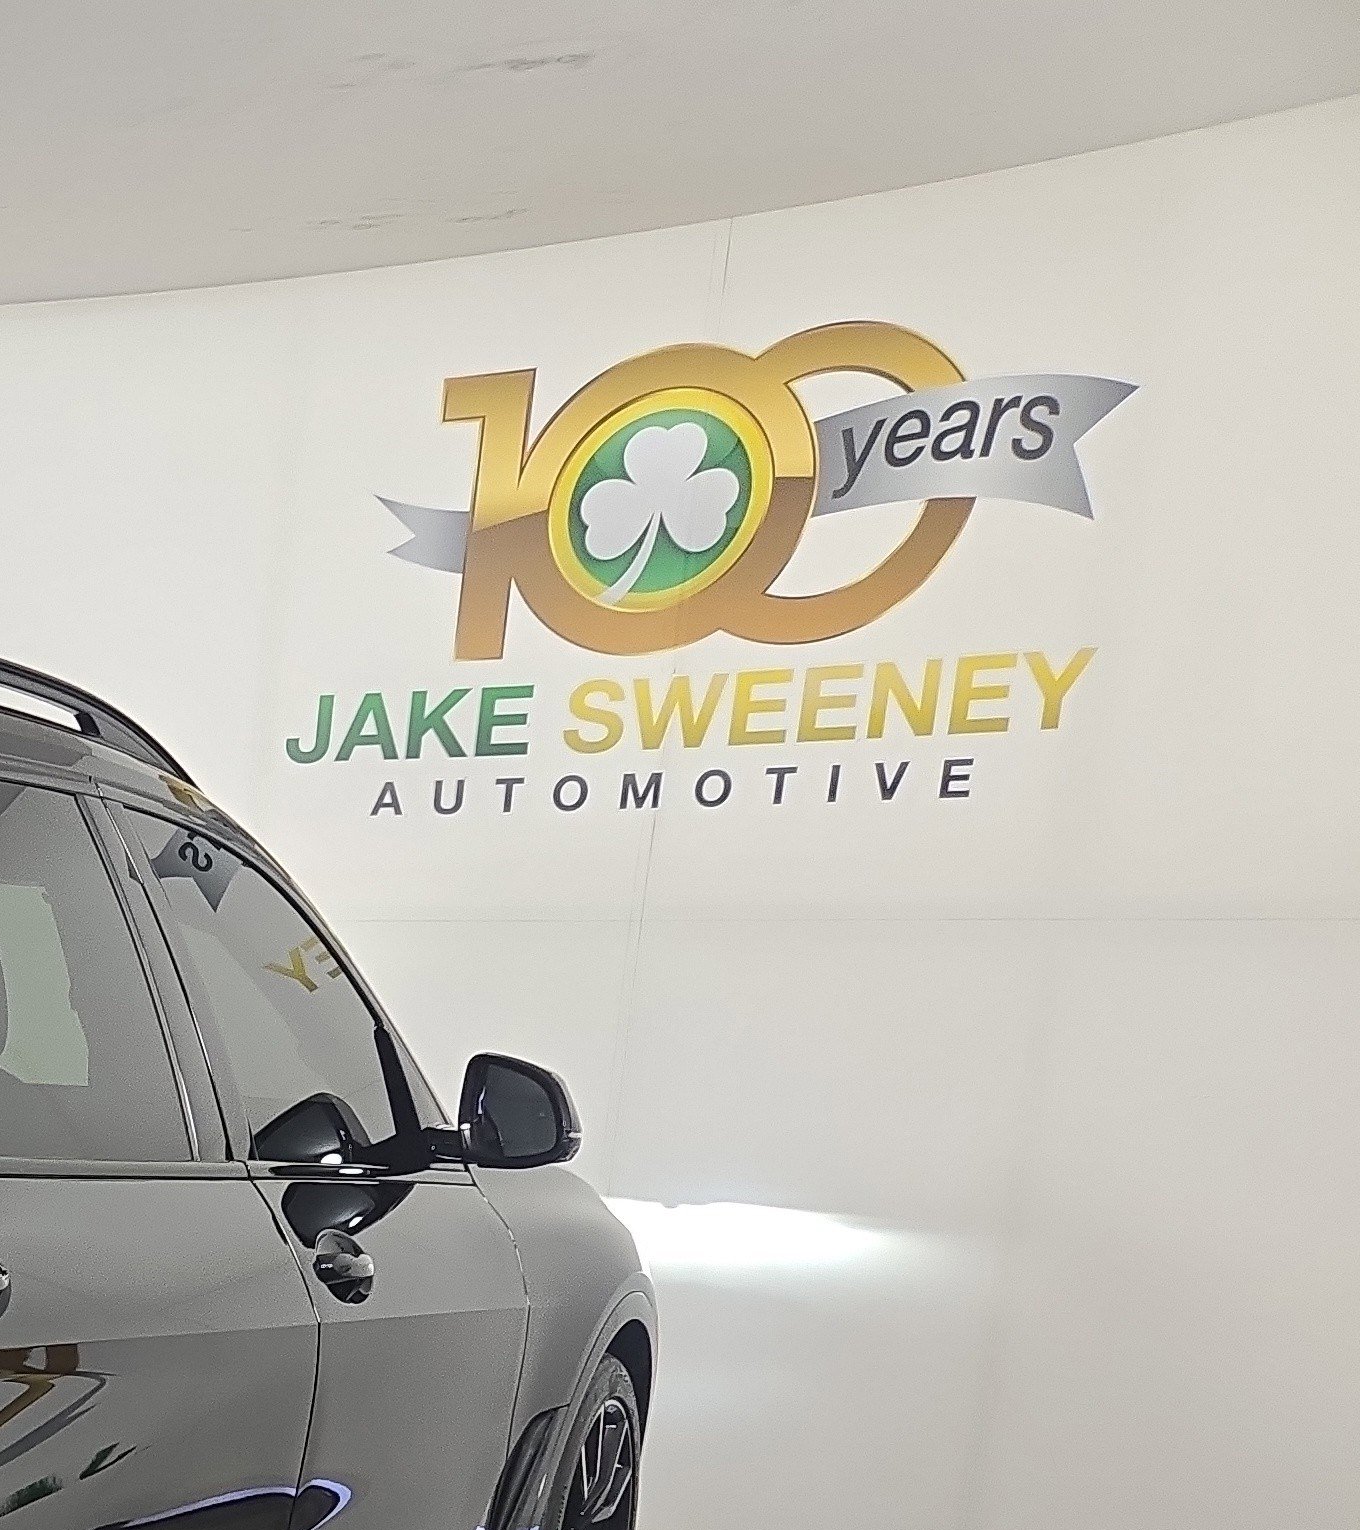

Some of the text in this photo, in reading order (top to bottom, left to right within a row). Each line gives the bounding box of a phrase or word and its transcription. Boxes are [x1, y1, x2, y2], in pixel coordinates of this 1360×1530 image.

[442, 320, 1060, 661] 100 years
[286, 646, 1099, 764] JAKE SWEENEY
[371, 757, 975, 816] AUTOMOTIVE
